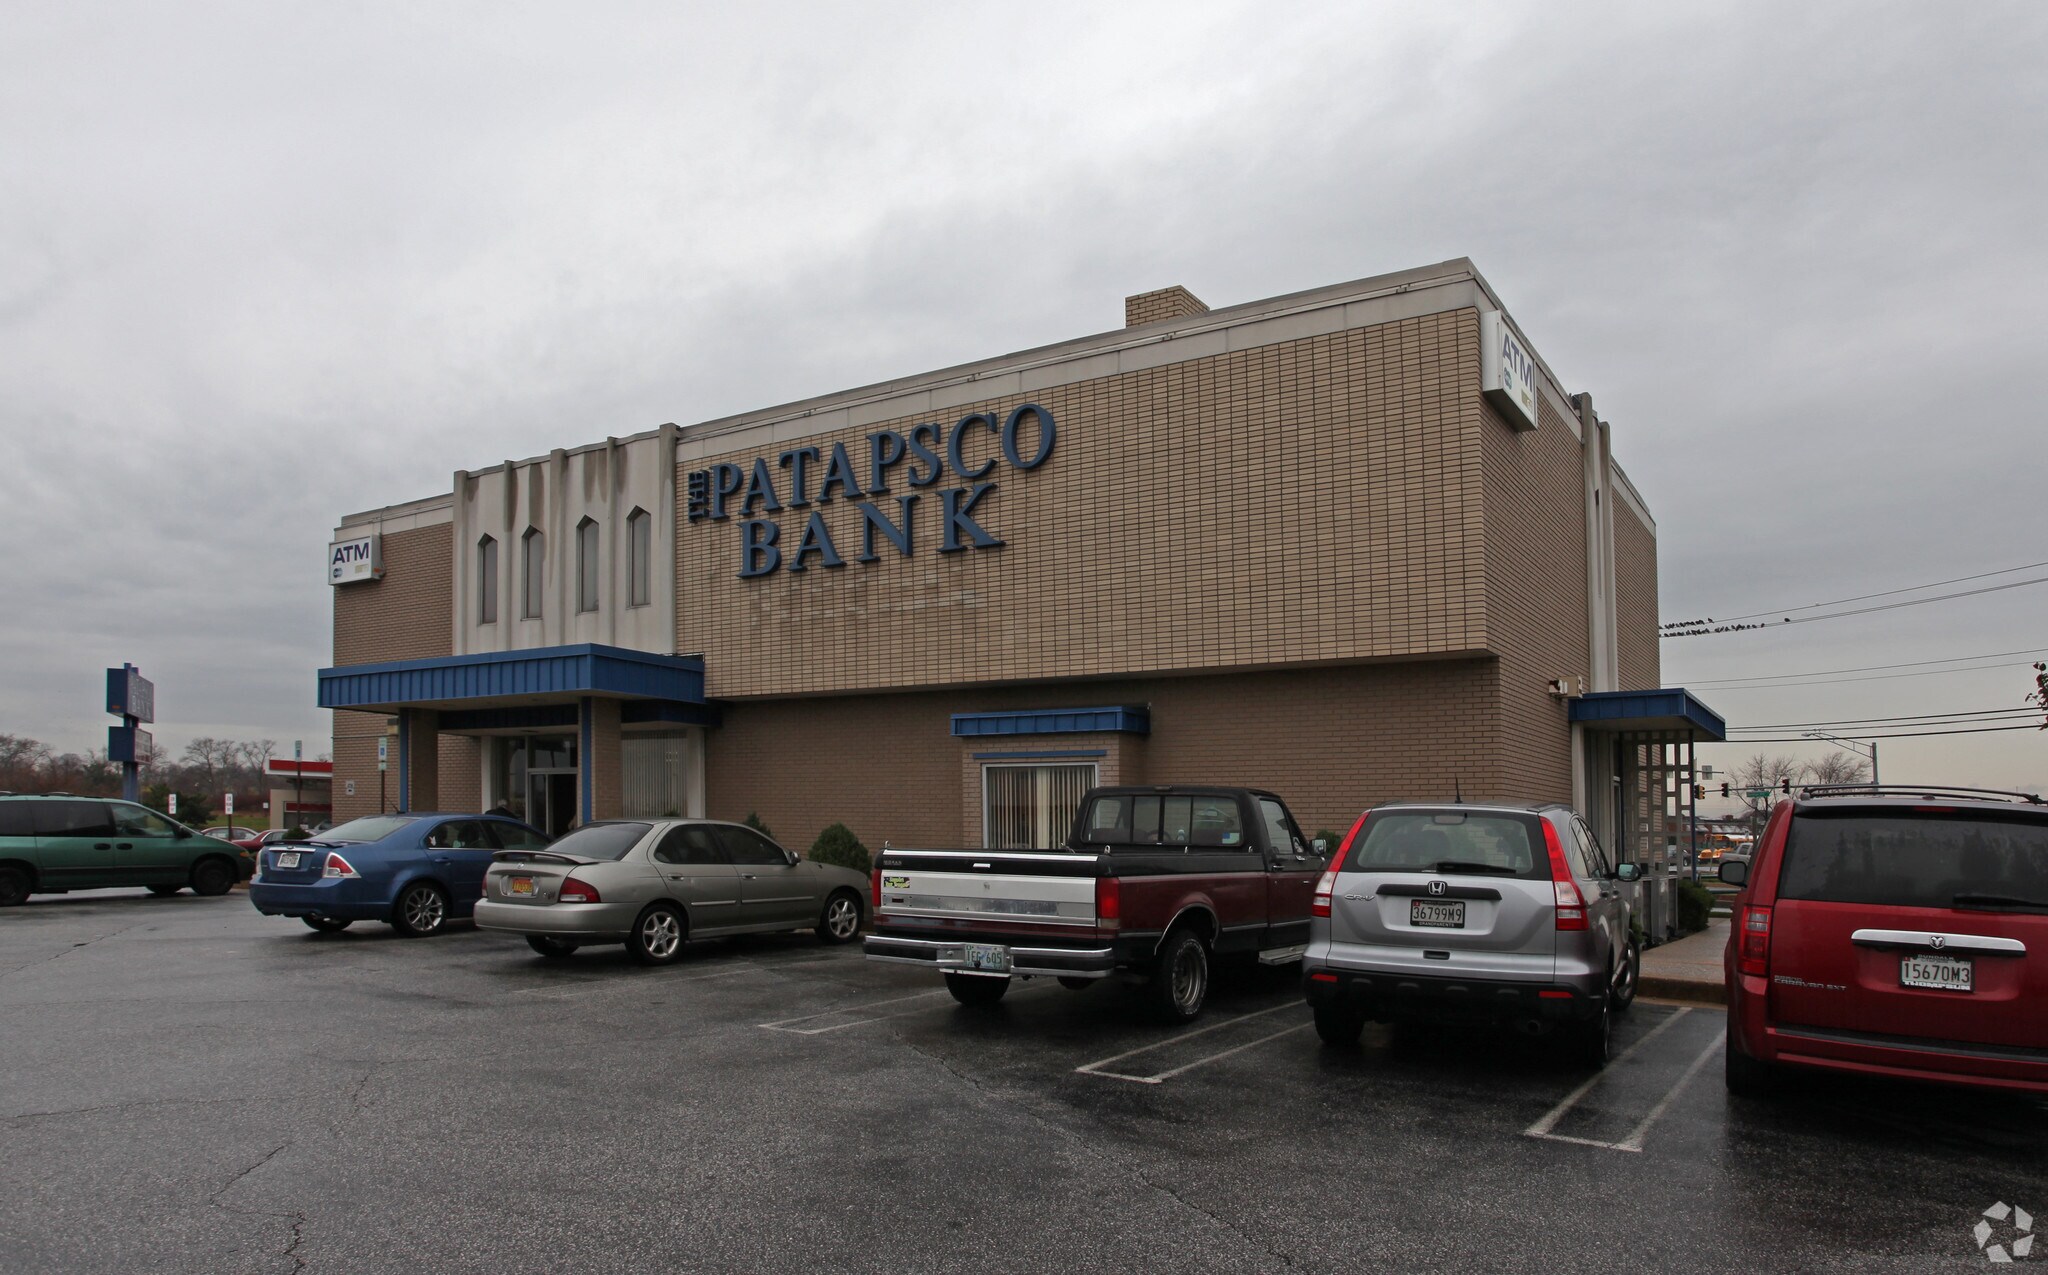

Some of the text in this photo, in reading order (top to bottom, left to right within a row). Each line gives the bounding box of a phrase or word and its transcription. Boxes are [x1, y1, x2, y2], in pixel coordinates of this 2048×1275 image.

[1503, 333, 1533, 393] ATM
[709, 403, 1057, 521] PATAPSCO
[688, 470, 710, 524] THE
[332, 542, 370, 566] ATM
[736, 482, 1006, 579] BANK
[1413, 906, 1462, 922] 36799M9
[1904, 963, 1970, 983] 15670M3
